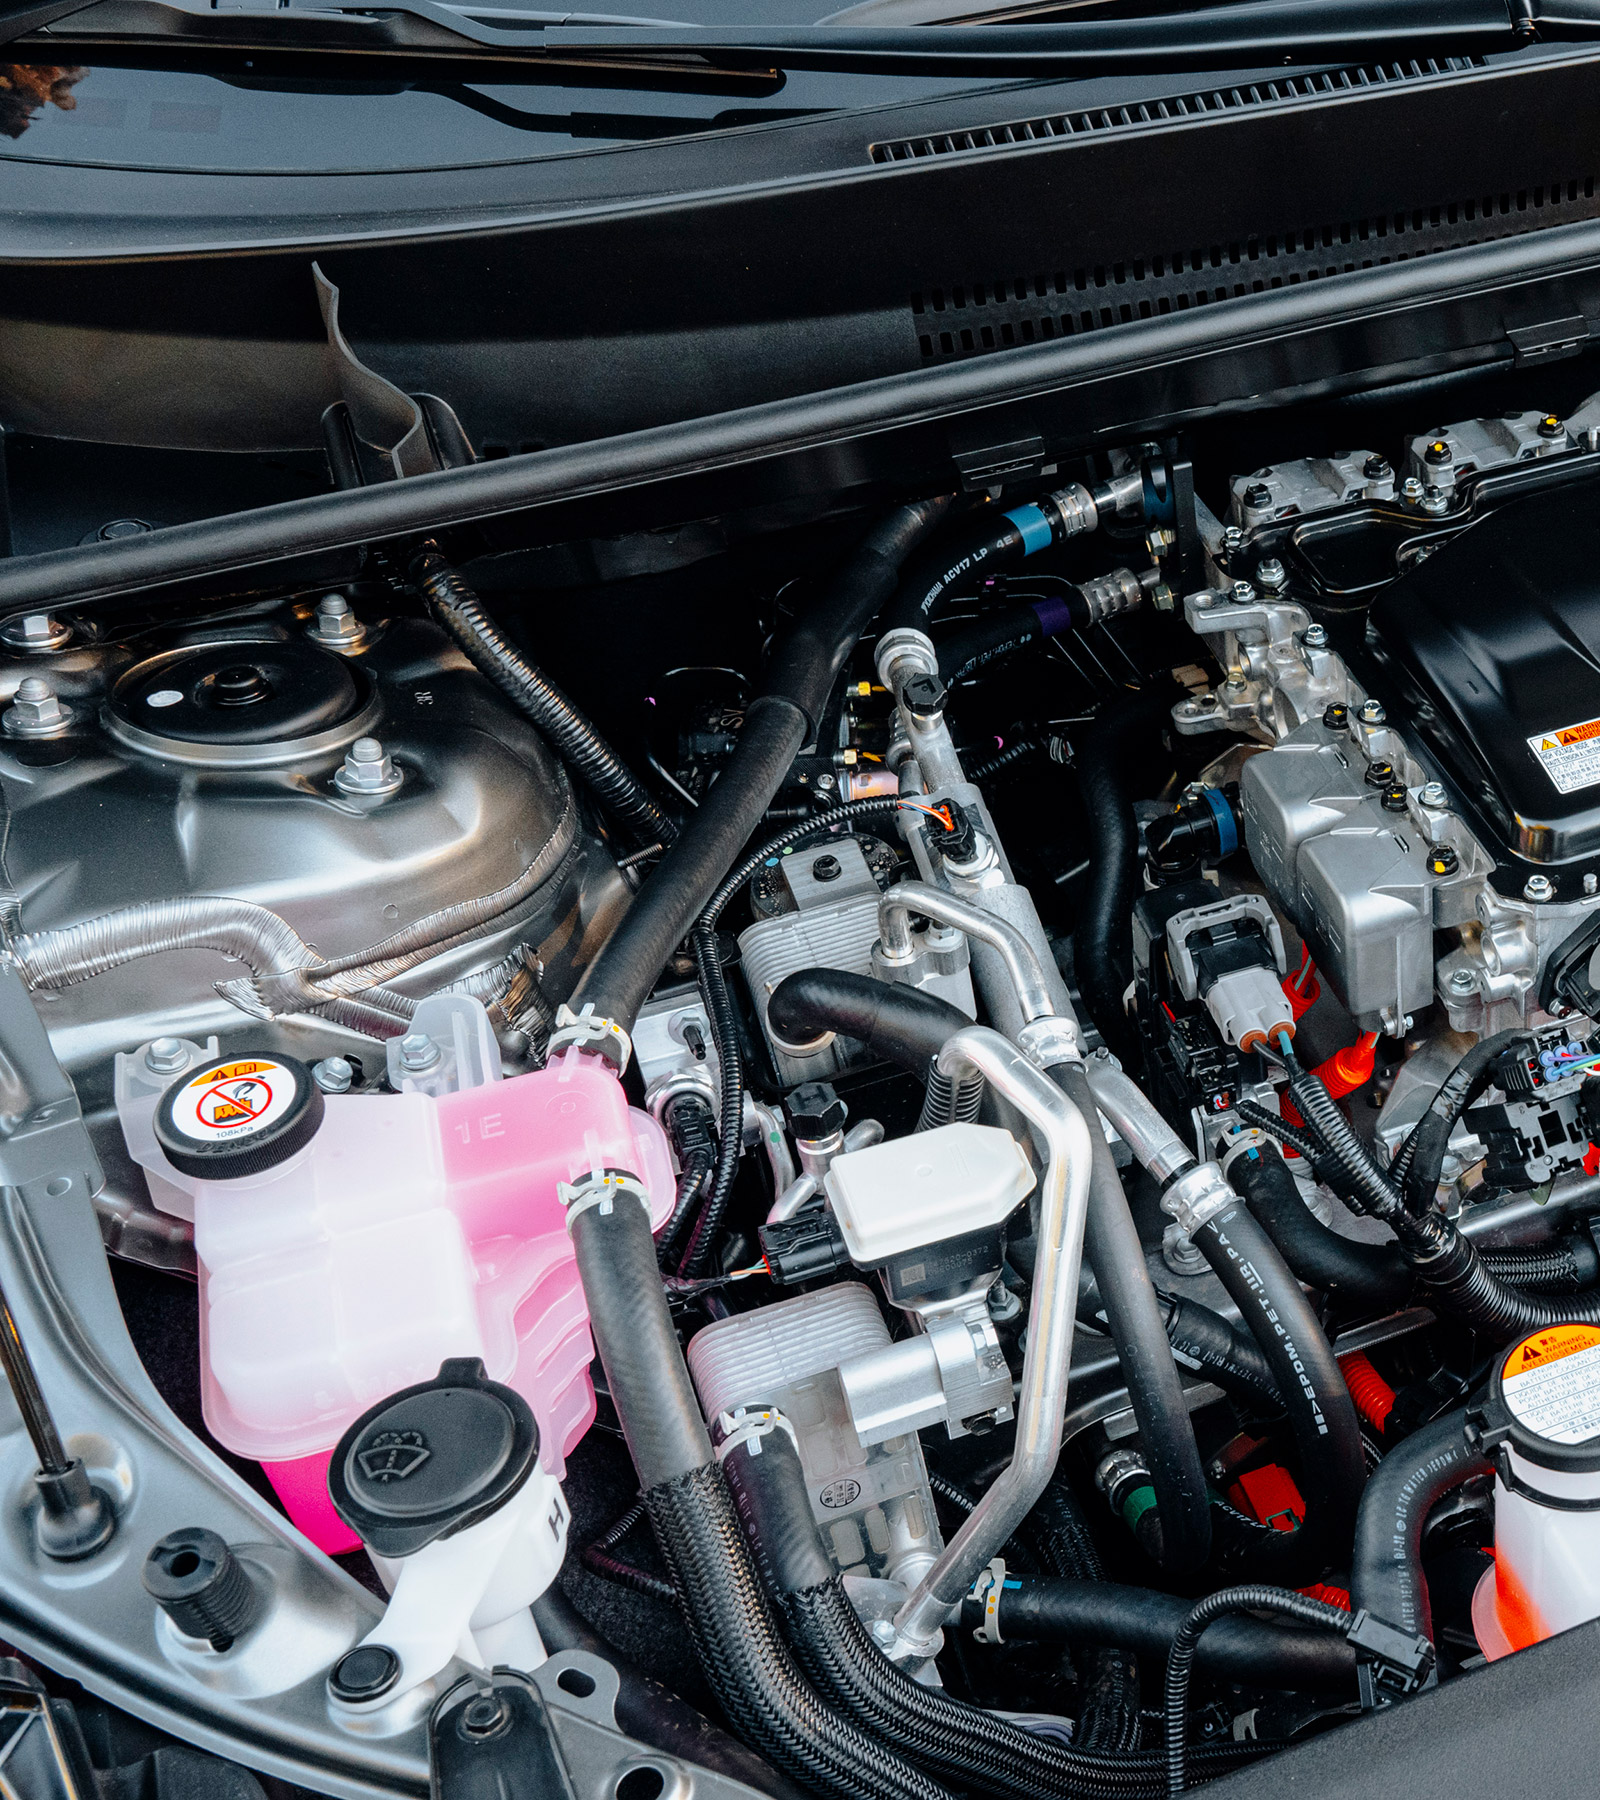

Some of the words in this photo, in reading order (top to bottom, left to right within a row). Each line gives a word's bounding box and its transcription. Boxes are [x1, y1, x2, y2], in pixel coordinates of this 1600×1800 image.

[942, 557, 972, 584] ACV17
[972, 547, 989, 562] LP
[995, 535, 1014, 550] 4E
[1545, 758, 1562, 766] HAUTE
[1560, 752, 1581, 762] TENSION
[1554, 747, 1574, 756] VOLTAGE
[1574, 742, 1589, 750] INSIDE
[794, 1084, 829, 1111] H
[217, 1126, 253, 1138] 108kPa
[454, 1112, 506, 1145] 1E
[1521, 1338, 1596, 1370] AVERTISSEMENT
[1540, 1336, 1557, 1347] 警告
[1544, 1334, 1585, 1354] WARNING
[1520, 1372, 1553, 1388] BATTERY
[1557, 1358, 1590, 1374] COOLANT
[1527, 1362, 1560, 1378] GENUINE
[1564, 1347, 1600, 1364] TRACTION
[1515, 1385, 1542, 1399] LIQUIDE
[1519, 1392, 1541, 1405] POUR
[1544, 1379, 1577, 1395] BATTERIE
[1582, 1373, 1591, 1381] DE
[1527, 1386, 1578, 1409] AUTHENTIQUE
[1526, 1404, 1555, 1419] LIQUIDE
[1550, 1401, 1583, 1416] BATTERIE
[1404, 1467, 1427, 1494] WATER
[547, 1496, 565, 1544] H
